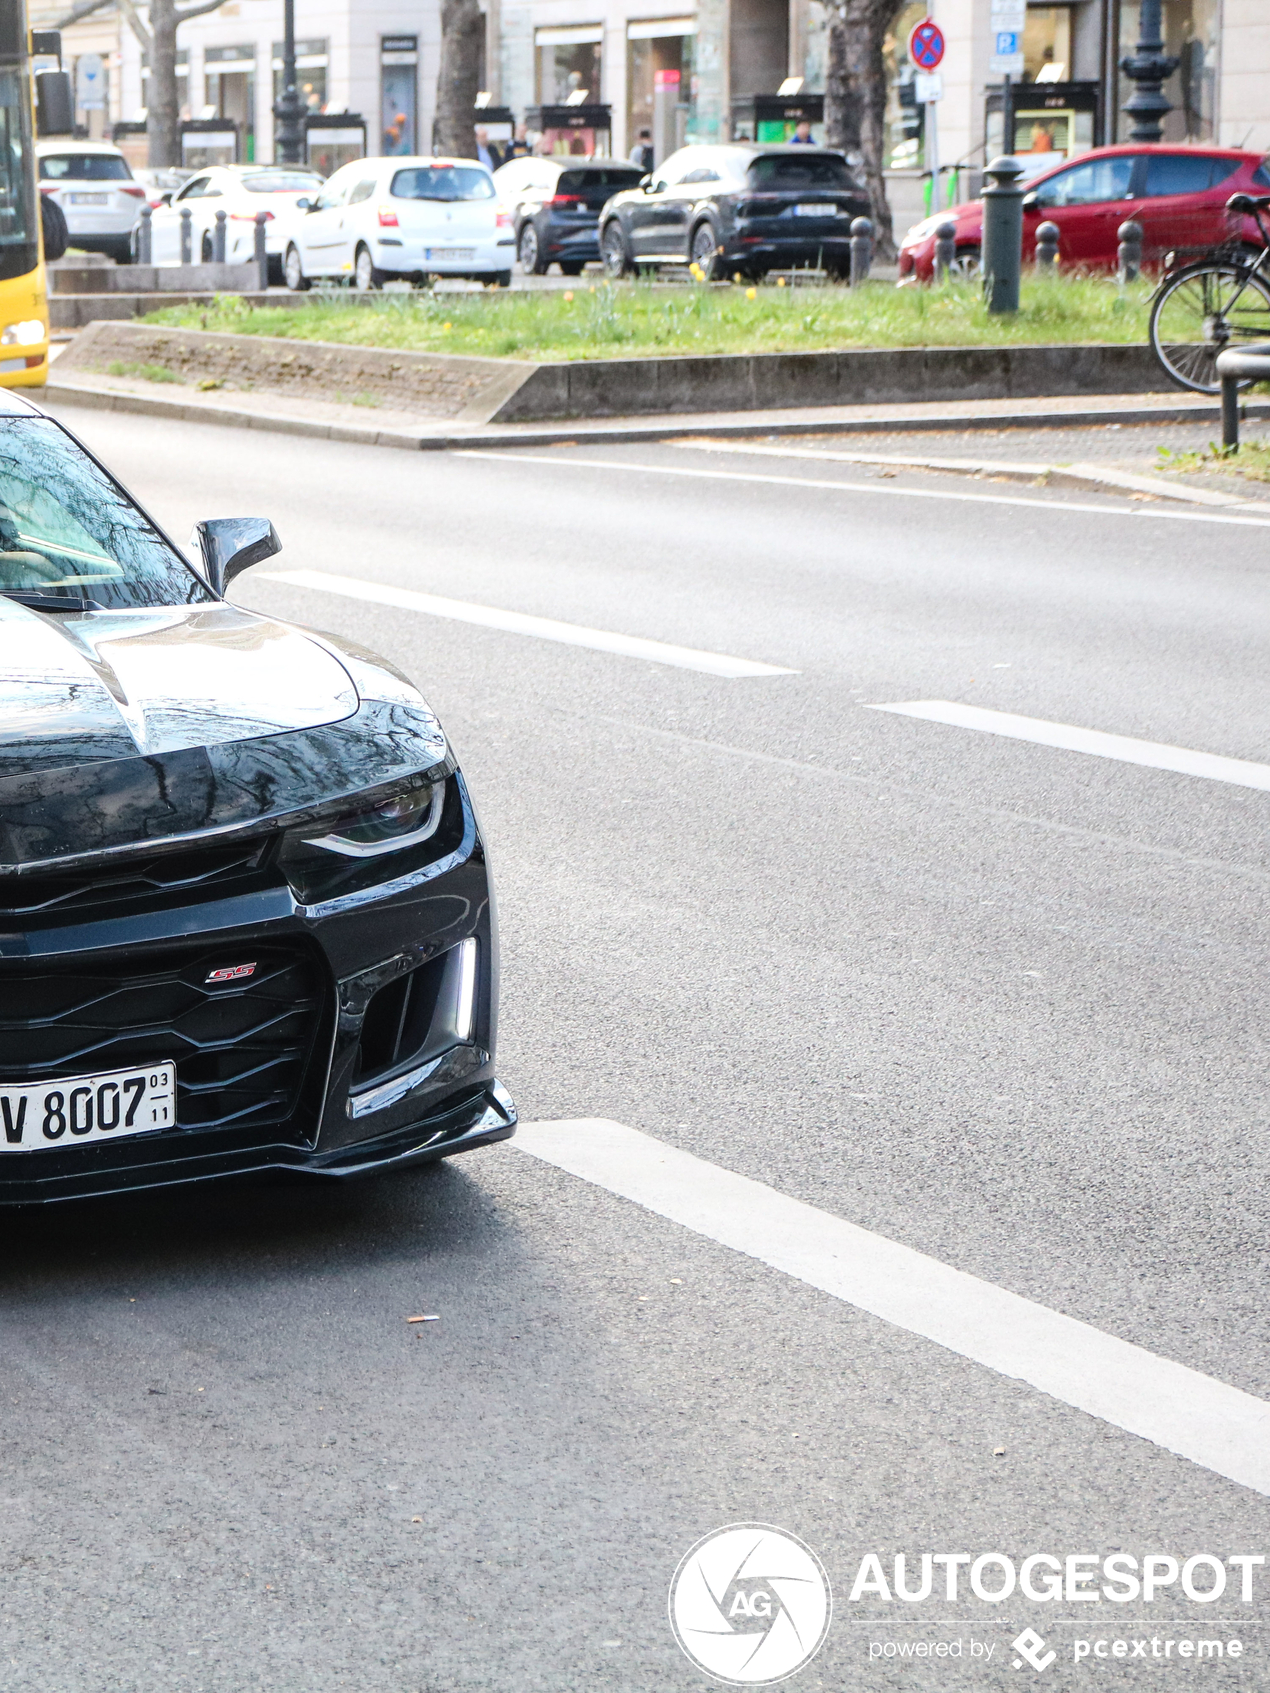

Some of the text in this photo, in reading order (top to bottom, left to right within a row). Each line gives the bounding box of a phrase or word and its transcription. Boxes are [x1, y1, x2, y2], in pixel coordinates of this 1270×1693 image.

[204, 962, 257, 984] SS
[149, 1072, 169, 1089] 03
[42, 1076, 146, 1141] 8007
[151, 1106, 169, 1123] 11
